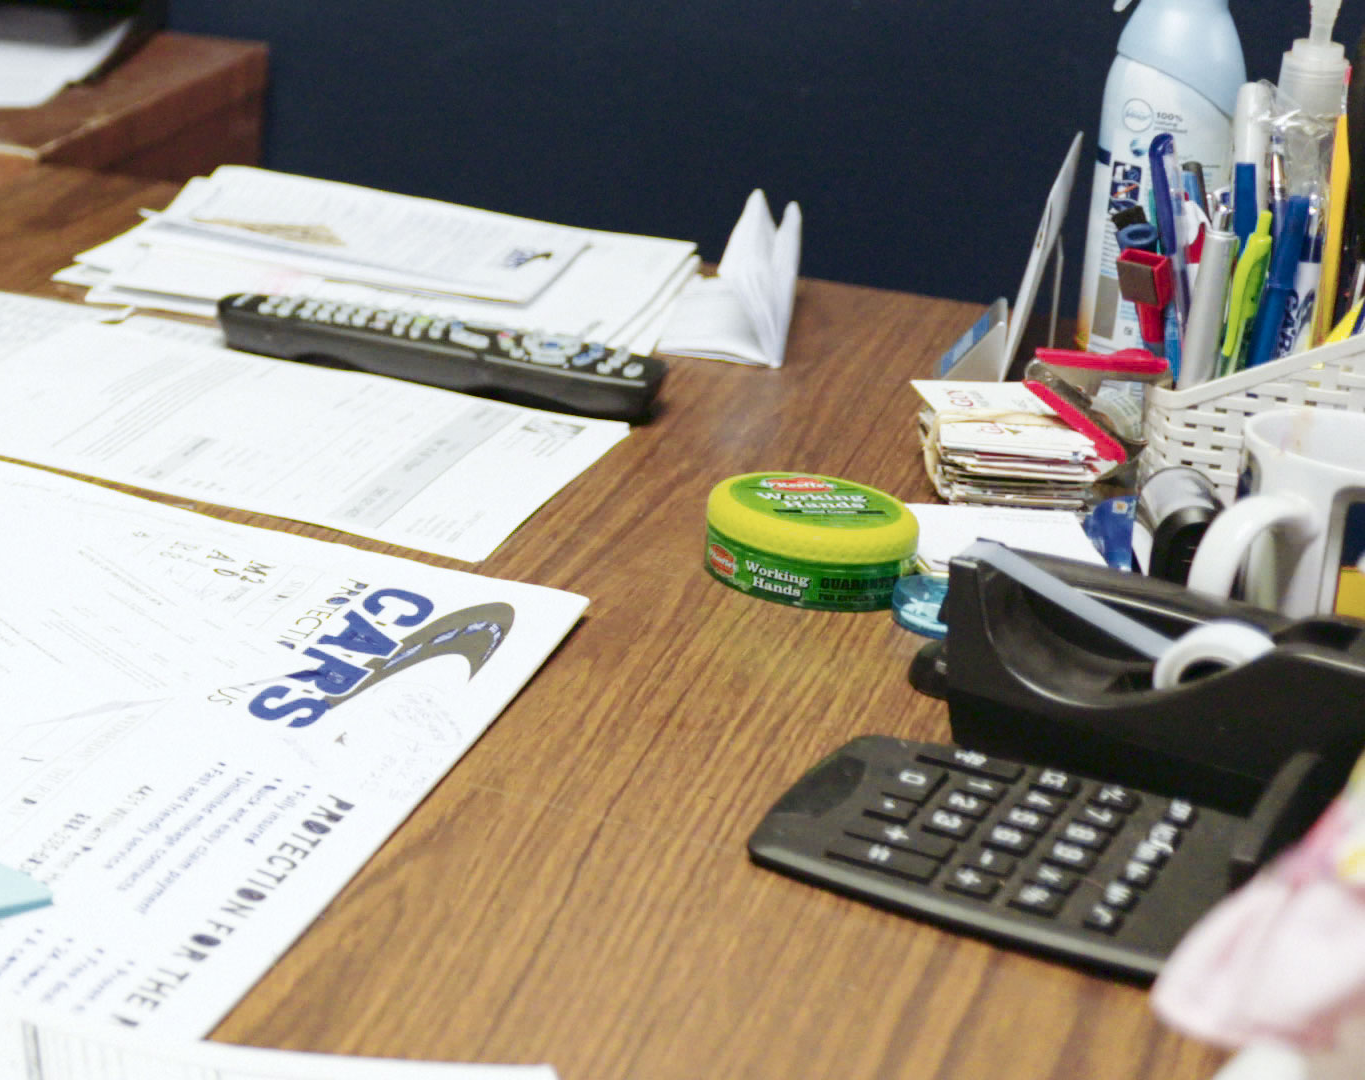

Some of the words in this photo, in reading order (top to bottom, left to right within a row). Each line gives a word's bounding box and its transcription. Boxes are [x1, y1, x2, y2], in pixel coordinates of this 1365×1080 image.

[756, 491, 868, 503] Working
[782, 499, 866, 510] Hands
[745, 559, 811, 588] Working
[752, 575, 801, 598] Hands
[196, 768, 223, 785] Fast
[178, 787, 198, 802] and
[201, 778, 250, 814] Unlimited
[248, 785, 277, 805] Quick
[274, 791, 306, 811] Fully
[138, 803, 184, 834] friendly
[228, 808, 248, 823] and
[243, 811, 283, 846] insured
[104, 837, 143, 869] service
[219, 794, 355, 918] PROTECTION
[139, 870, 181, 914] payment
[173, 919, 236, 962] FOR
[124, 968, 190, 1010] THE
